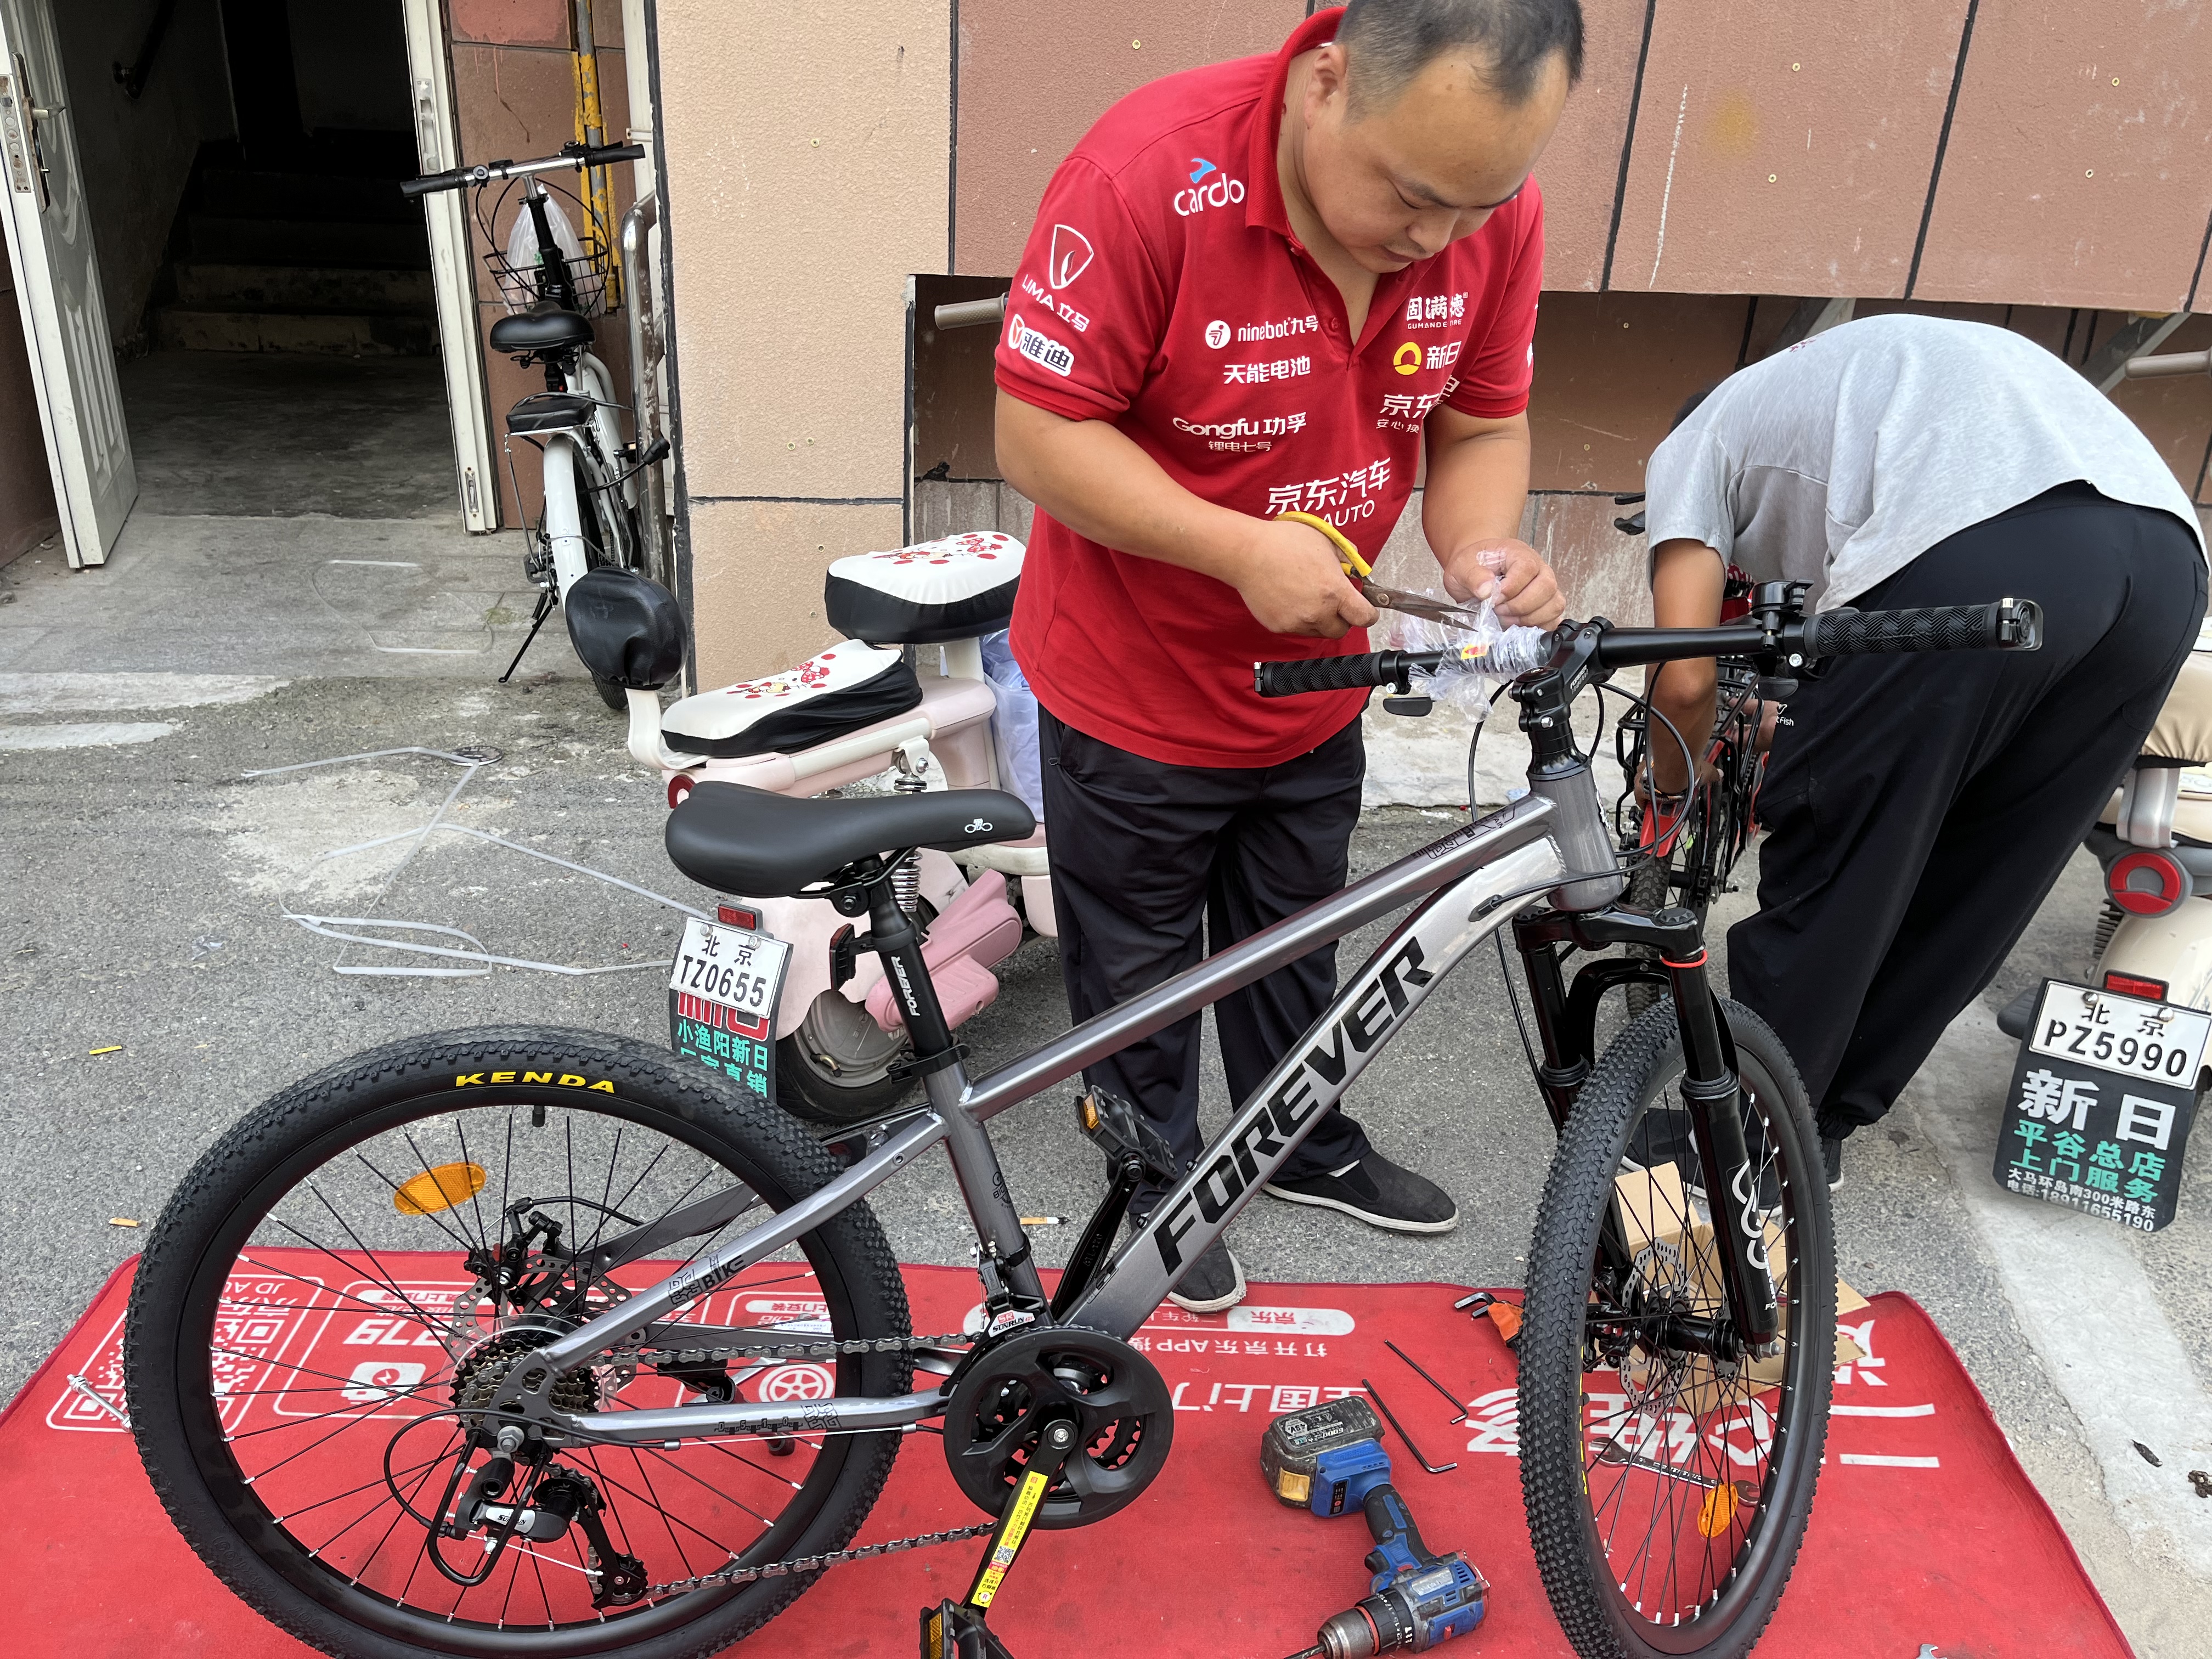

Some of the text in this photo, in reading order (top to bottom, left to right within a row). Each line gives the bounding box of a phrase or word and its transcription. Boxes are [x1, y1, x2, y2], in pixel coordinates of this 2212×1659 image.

[1174, 173, 1245, 217] cardo
[1022, 274, 1090, 332] LIMA 立马
[1406, 293, 1465, 322] 固满德
[1238, 314, 1319, 342] ninebot 九号
[1407, 321, 1448, 330] GUMANDE
[1022, 331, 1070, 372] 雅迪
[1426, 341, 1462, 370] 新日
[1223, 355, 1311, 385] 天能电池
[1172, 411, 1307, 439] Gongfu 功孚
[1208, 441, 1272, 453] 锂电七号
[1265, 456, 1391, 515] 京东汽车
[701, 934, 757, 967] 北京
[680, 955, 767, 1008] TZ0655
[2081, 1003, 2165, 1037] 北京
[678, 1019, 768, 1071] 小渔阳新日
[2044, 1019, 2187, 1077] PZ5990
[455, 1070, 616, 1094] KENDA
[1153, 936, 1435, 1277] FOREVER
[2018, 1068, 2177, 1151] 新日
[2013, 1119, 2166, 1182] 平谷总店
[2010, 1148, 2158, 1203] 上门服务
[2008, 1167, 2157, 1219] 大马环岛南300米路东
[255, 1280, 286, 1295] JD
[992, 1317, 1024, 1333] SUNRUN
[998, 1312, 1014, 1323] SR
[1251, 1311, 1296, 1325] 京东
